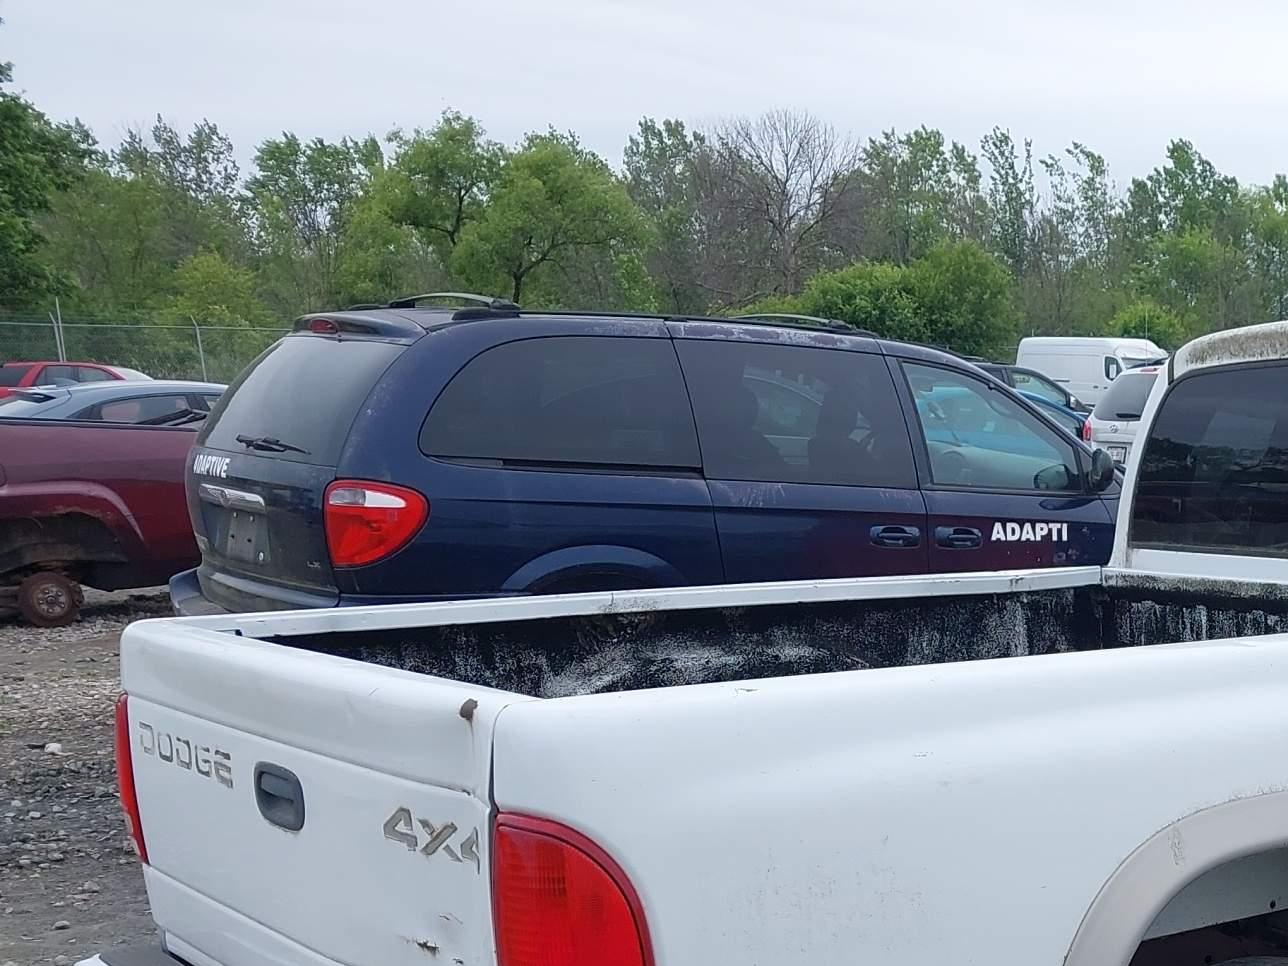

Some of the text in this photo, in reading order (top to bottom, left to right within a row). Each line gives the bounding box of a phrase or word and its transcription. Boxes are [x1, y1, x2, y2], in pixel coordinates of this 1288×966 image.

[193, 454, 231, 478] ADAPTIVE
[991, 522, 1068, 541] ADAPTI
[139, 721, 233, 789] DODGE
[383, 806, 480, 875] 4X4
